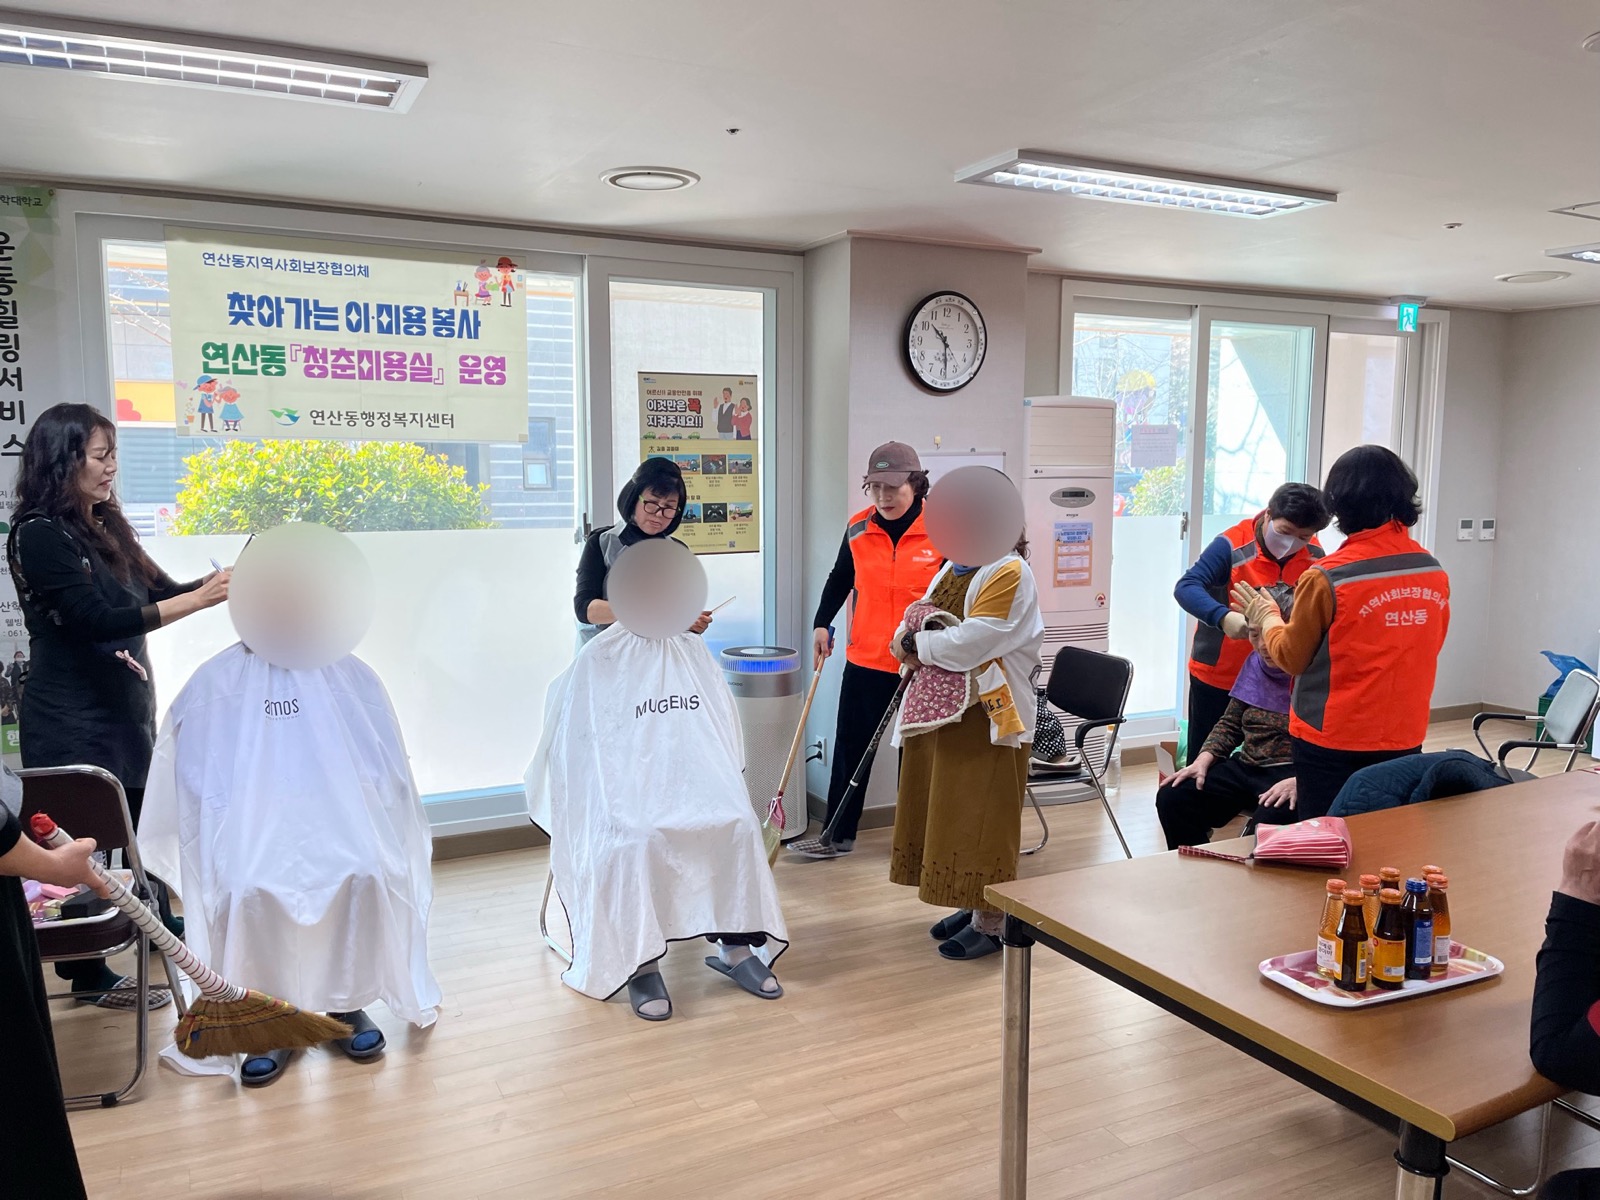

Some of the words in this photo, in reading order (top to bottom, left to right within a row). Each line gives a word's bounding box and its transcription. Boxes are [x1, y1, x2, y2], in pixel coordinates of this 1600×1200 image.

[202, 252, 370, 278] 연산동지역사회보장협의체
[227, 291, 340, 332] 찾아가는
[432, 307, 481, 340] 봉사
[931, 311, 938, 321] 11
[943, 307, 952, 318] 12
[921, 321, 930, 332] 10
[964, 324, 970, 334] 2
[917, 336, 923, 346] 9
[966, 339, 972, 349] 3
[458, 354, 507, 386] 운영
[646, 399, 687, 412] 이것만은
[310, 409, 455, 429] 연산동행정복지센터
[1385, 608, 1428, 627] 연산동
[264, 698, 299, 716] amos
[635, 694, 700, 719] MUGENS
